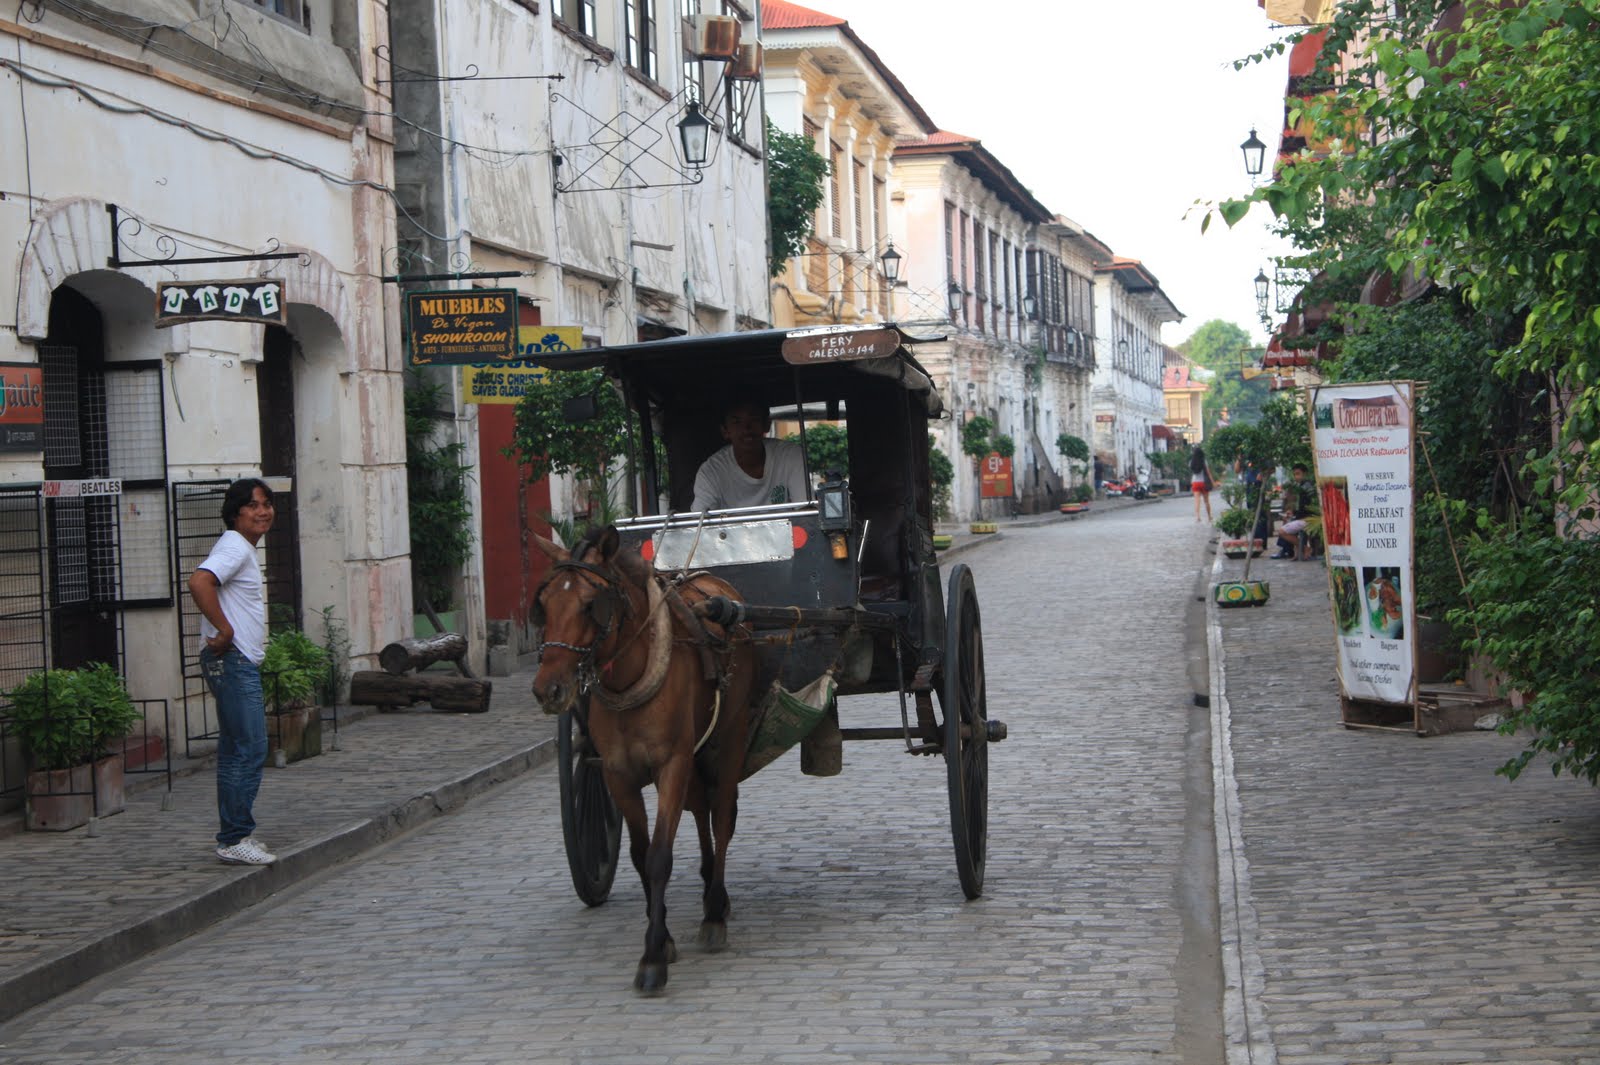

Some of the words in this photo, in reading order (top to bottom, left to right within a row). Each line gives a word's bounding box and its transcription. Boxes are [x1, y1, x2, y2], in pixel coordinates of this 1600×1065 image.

[168, 291, 273, 309] JADE
[420, 297, 506, 316] MUEBLES
[431, 317, 449, 329] De
[452, 316, 495, 332] Vigan
[420, 331, 507, 345] SHOWROOM
[821, 336, 853, 348] FERY
[809, 347, 846, 359] CALESA
[856, 344, 875, 355] 144
[472, 385, 497, 396] SAVES
[1339, 401, 1383, 428] Cordillera
[1365, 472, 1375, 480] WE
[1376, 471, 1394, 480] SERVE
[81, 481, 120, 494] BEATLES
[1358, 507, 1404, 518] BREAKFAST
[1368, 522, 1395, 534] LUNCH
[1366, 538, 1397, 549] DINNER
